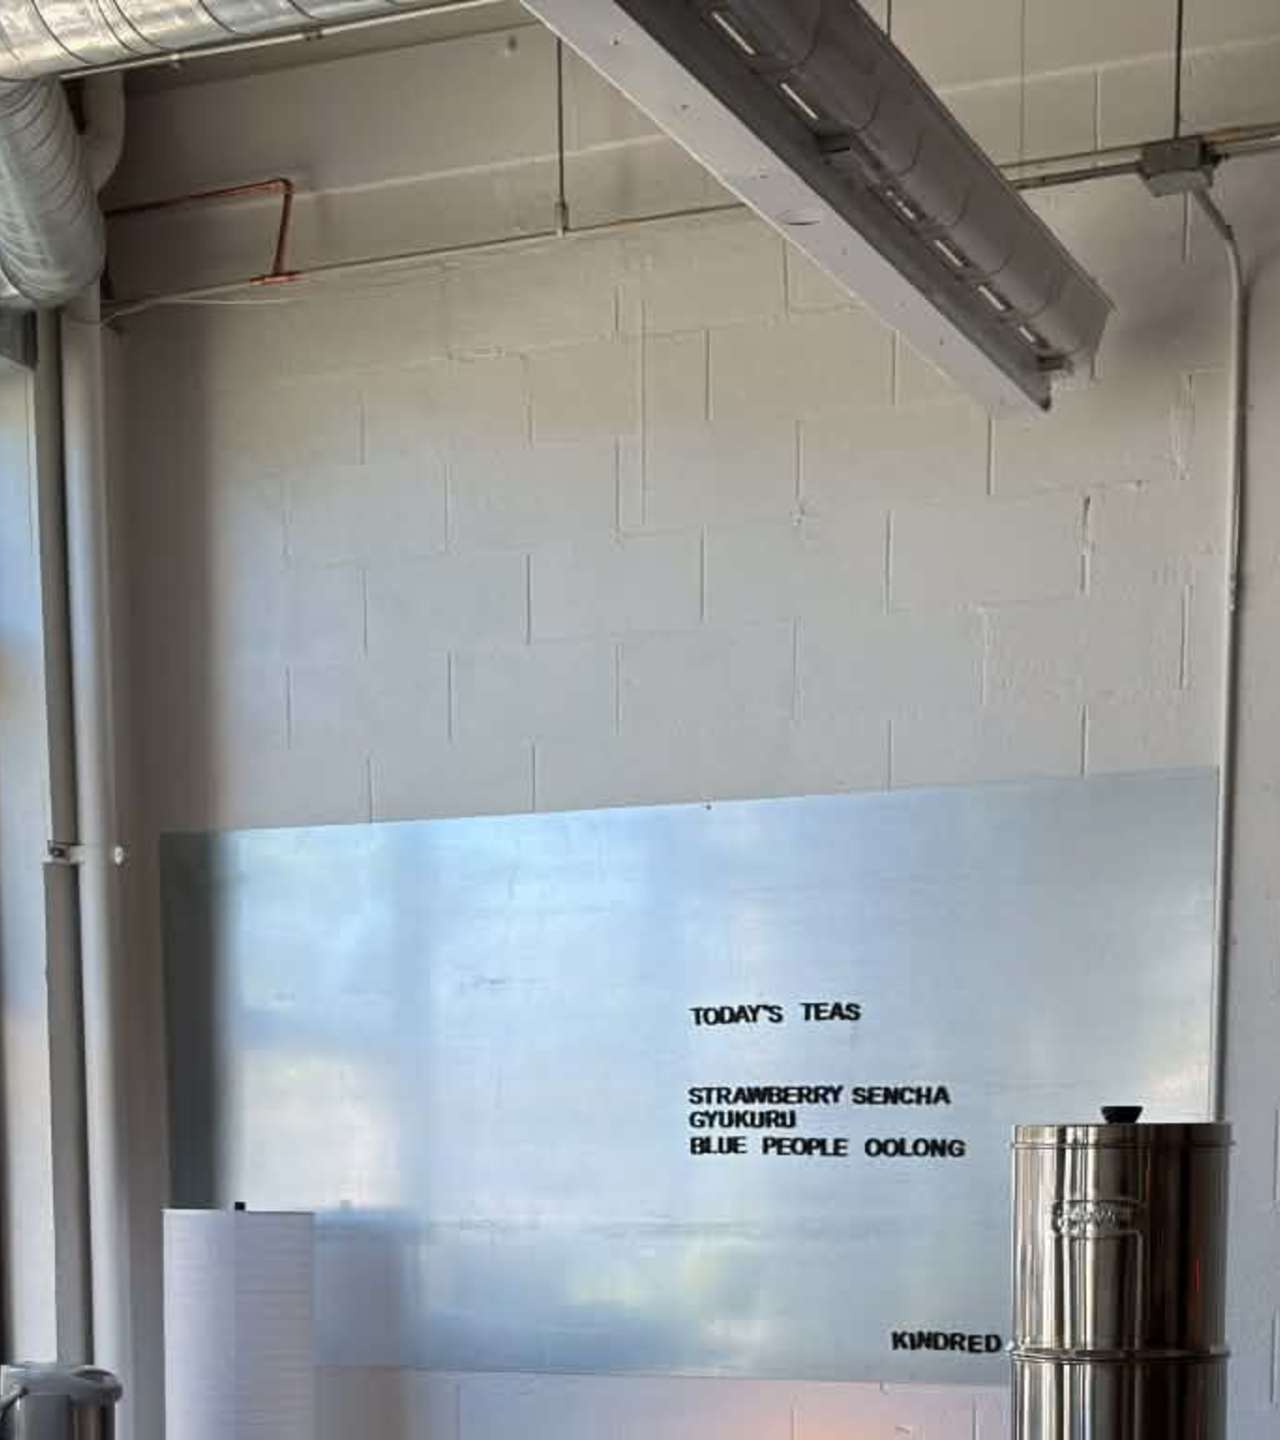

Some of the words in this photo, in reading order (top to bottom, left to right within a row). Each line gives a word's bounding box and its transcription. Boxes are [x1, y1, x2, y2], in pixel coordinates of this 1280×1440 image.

[689, 1004, 784, 1026] TODAY'S
[800, 1002, 862, 1022] TEAS
[688, 1085, 844, 1105] STRAWBERRY
[852, 1085, 951, 1105] SENCHA
[690, 1136, 746, 1156] BLUE
[762, 1137, 849, 1157] PEOPLE
[864, 1138, 966, 1158] OOLONG
[891, 1330, 1003, 1354] KINDRED
